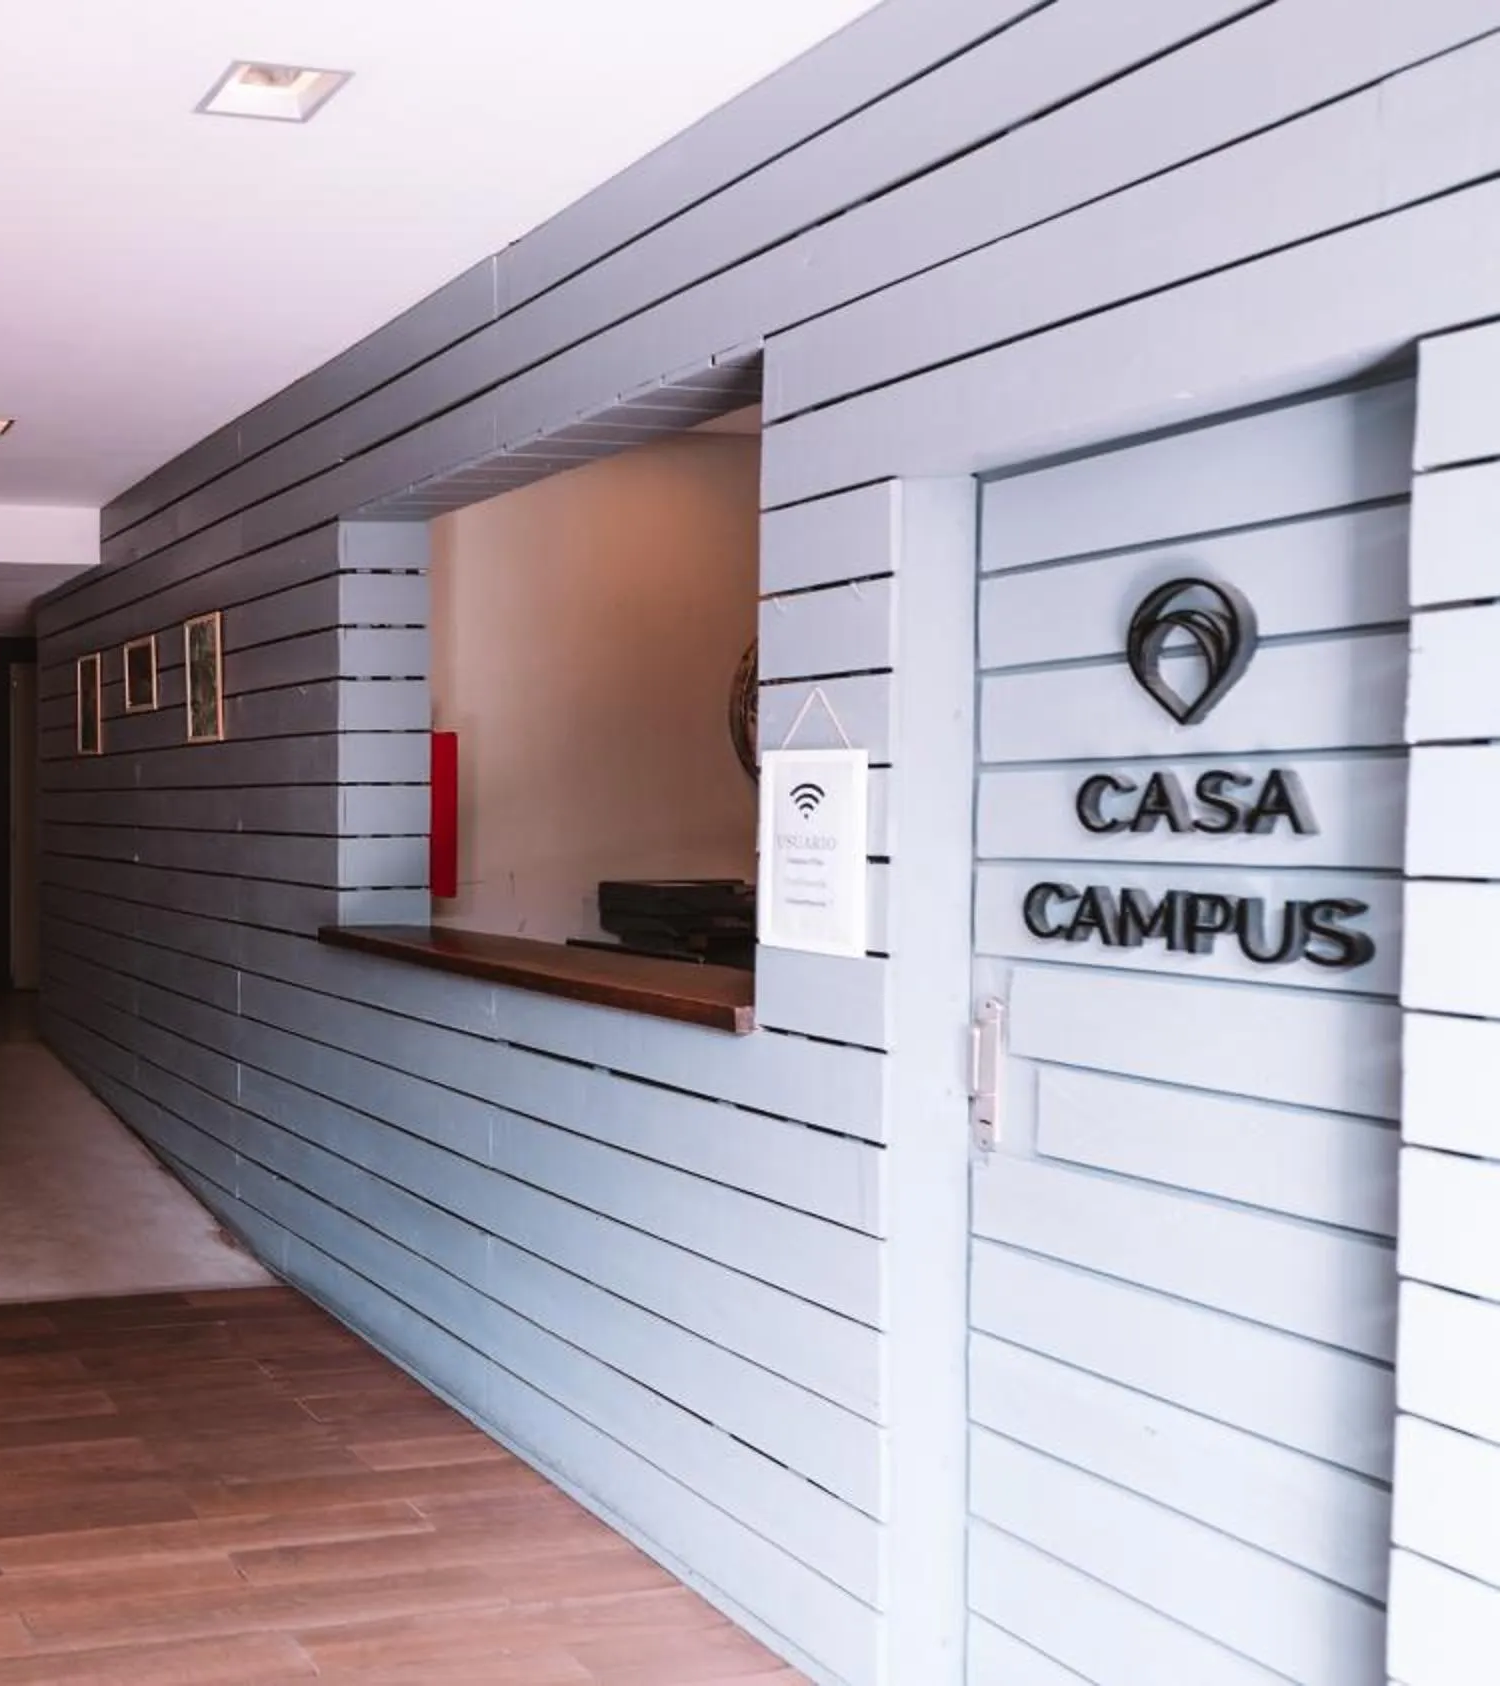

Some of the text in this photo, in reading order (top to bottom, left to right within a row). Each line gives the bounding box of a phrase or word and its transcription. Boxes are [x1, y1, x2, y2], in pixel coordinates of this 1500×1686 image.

[1075, 768, 1320, 835] CASA
[777, 834, 838, 851] USUARIO
[1023, 881, 1377, 968] CAMPUS
